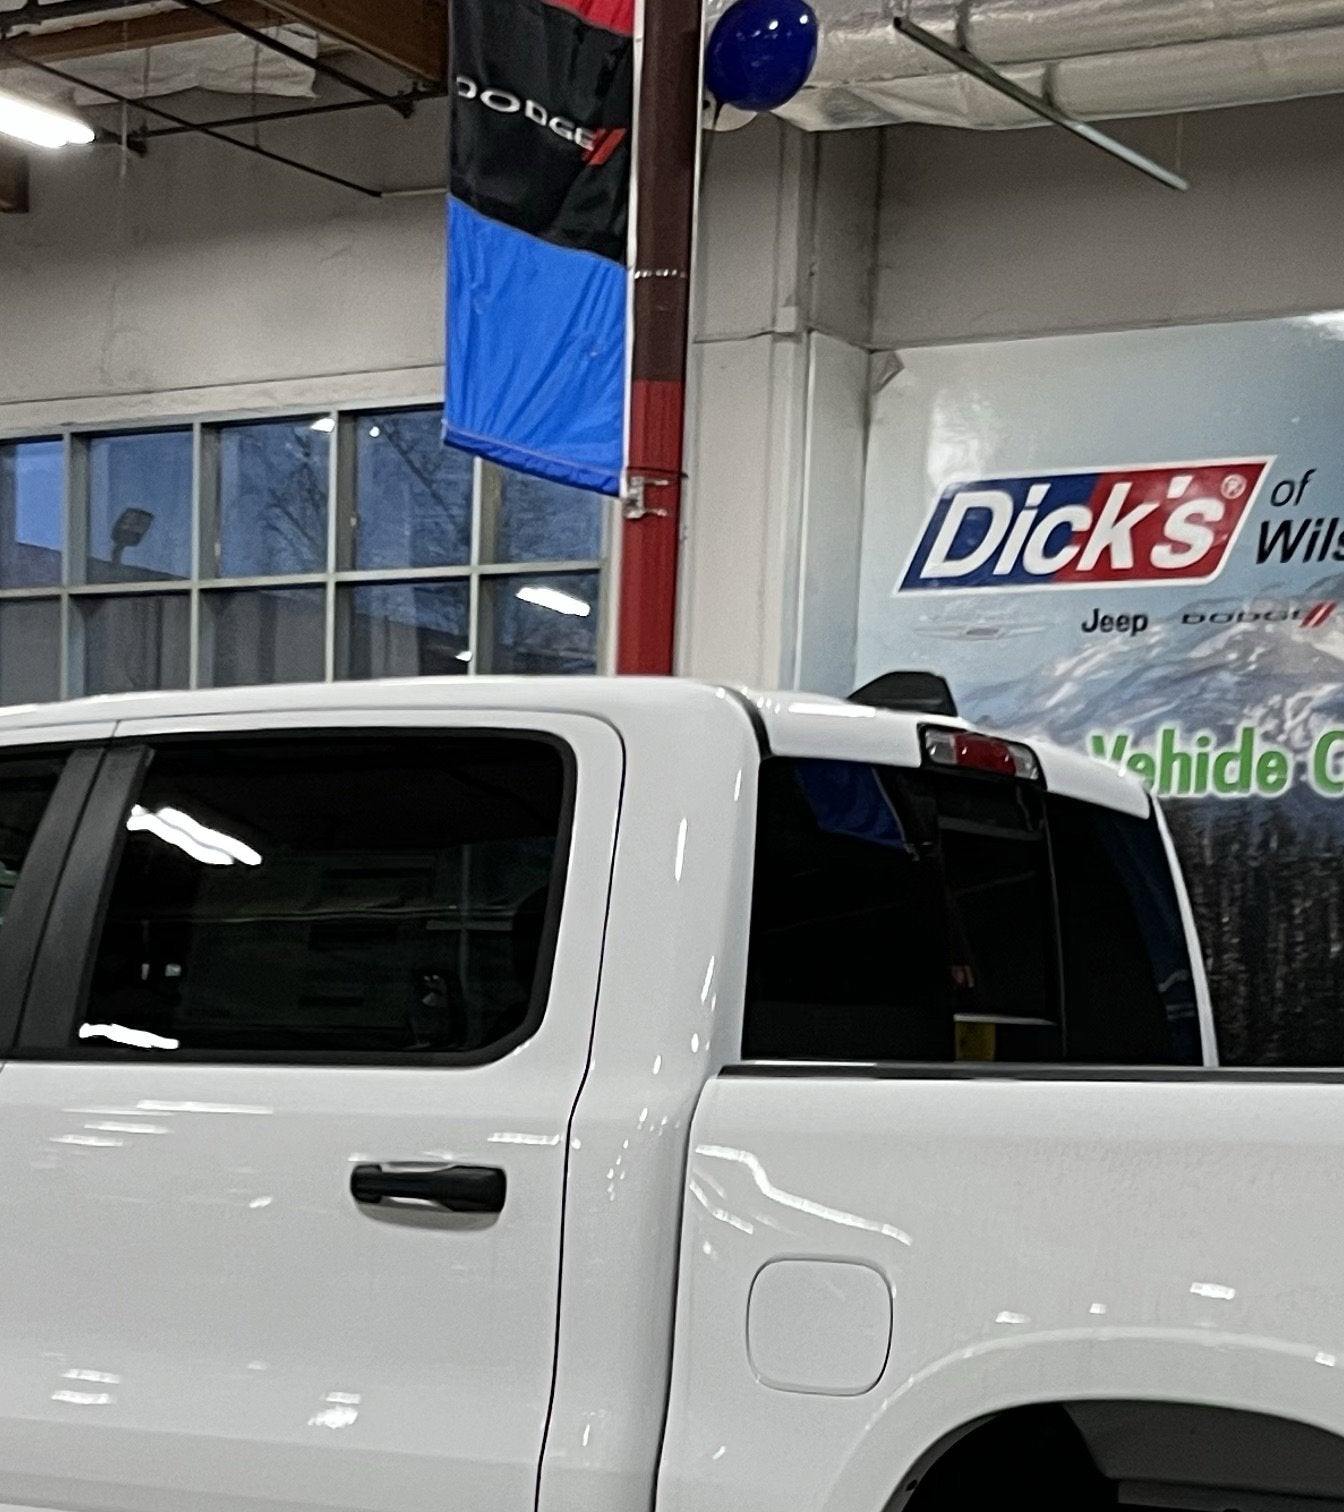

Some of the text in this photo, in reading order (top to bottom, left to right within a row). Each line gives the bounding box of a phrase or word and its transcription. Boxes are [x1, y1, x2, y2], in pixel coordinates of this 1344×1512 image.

[456, 75, 595, 151] DODGE
[1270, 469, 1317, 507] of
[919, 475, 1226, 579] Dick's
[1081, 608, 1149, 634] Jeep
